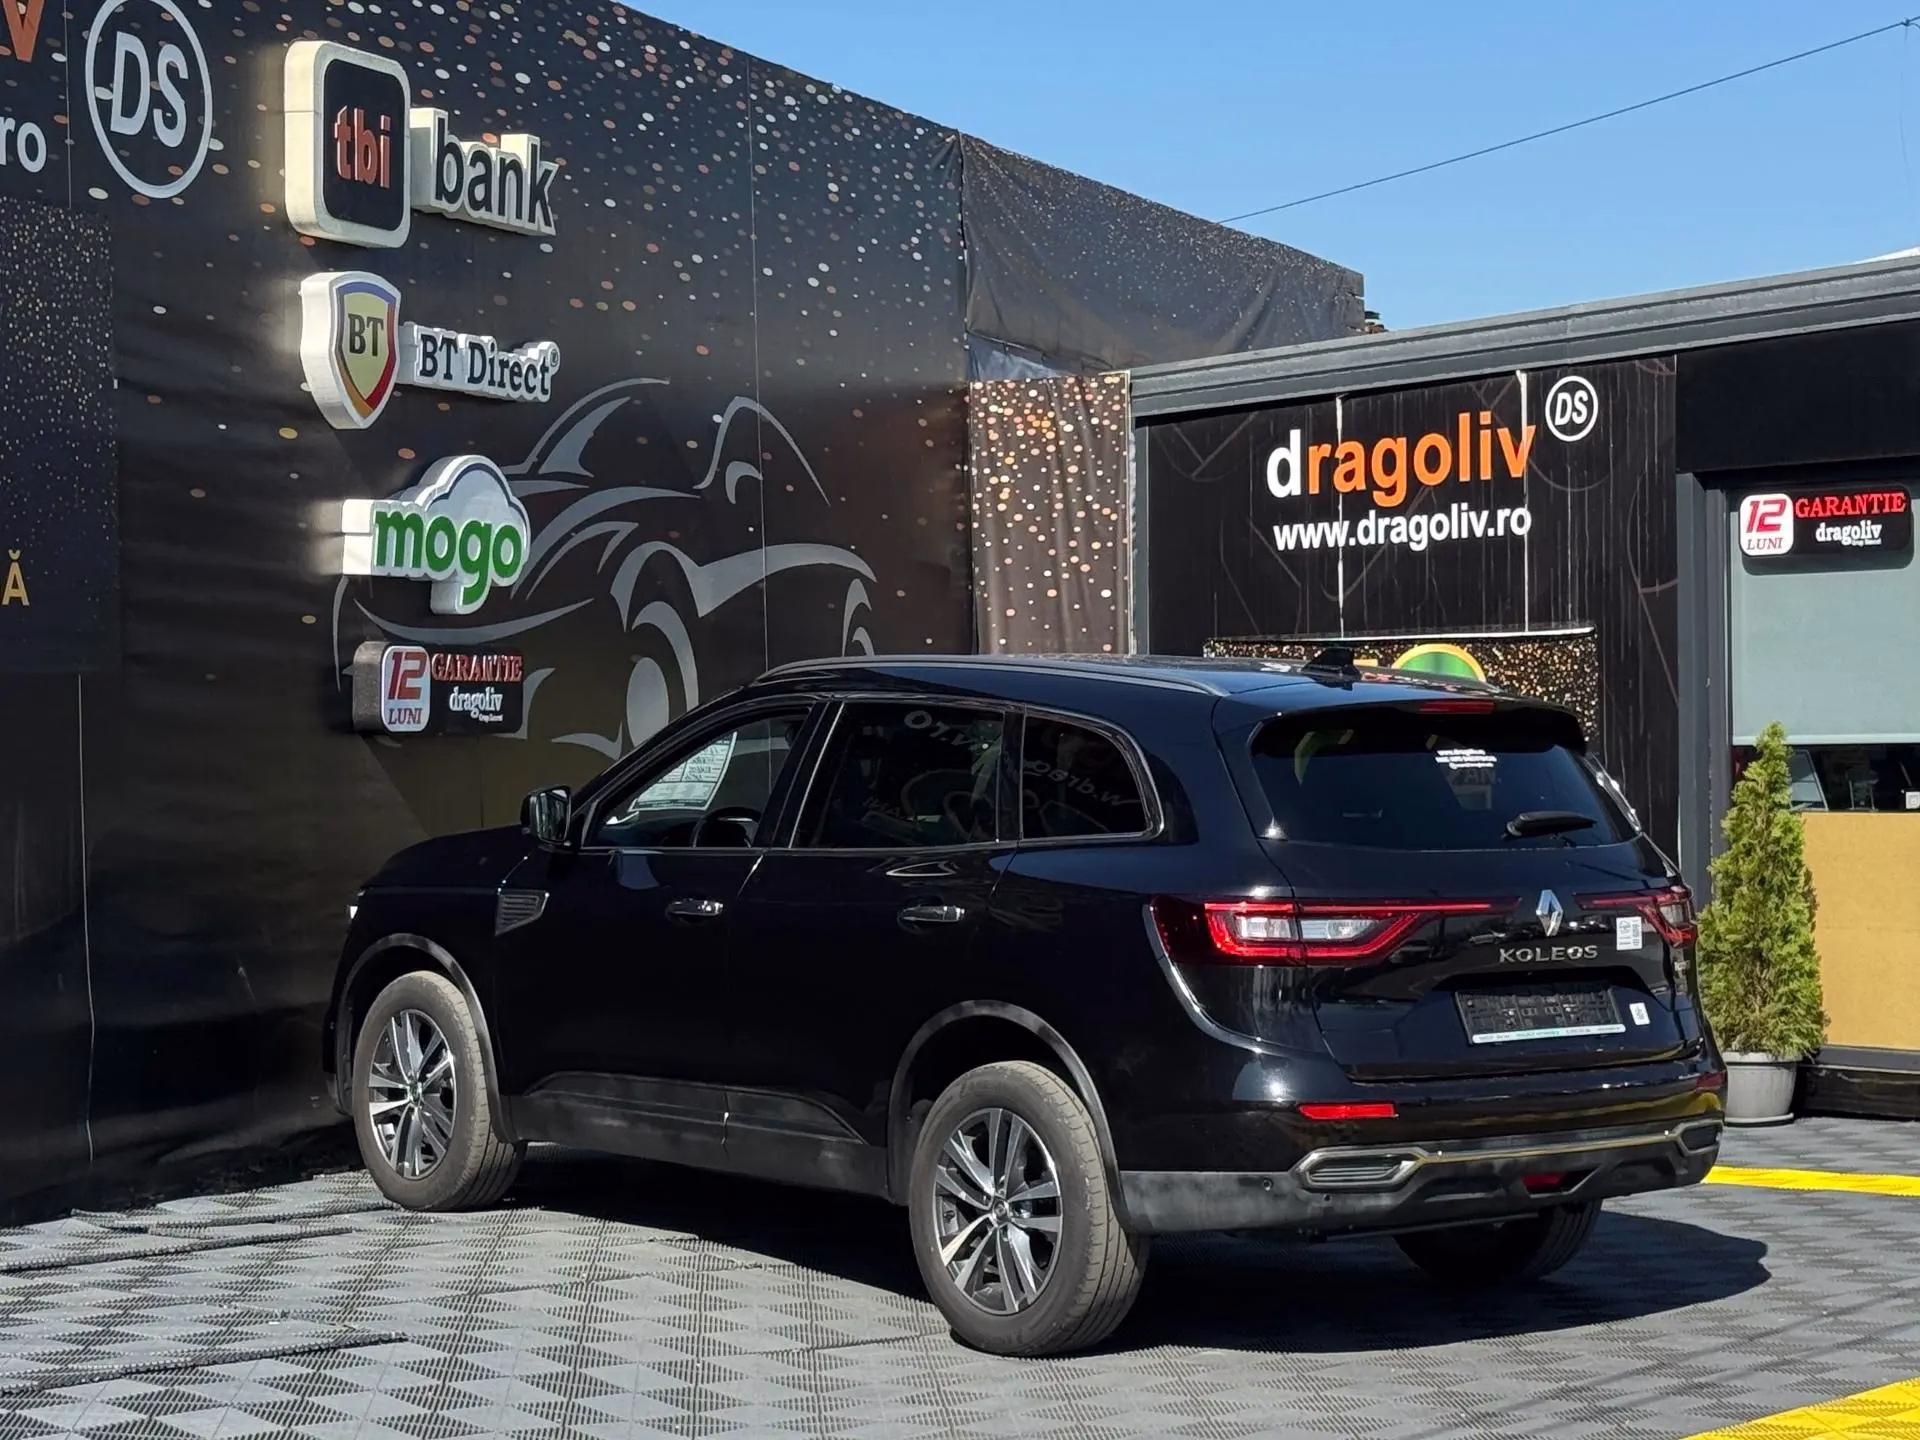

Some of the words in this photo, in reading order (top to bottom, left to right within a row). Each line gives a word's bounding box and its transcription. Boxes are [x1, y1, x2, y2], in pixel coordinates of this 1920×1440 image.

[110, 31, 188, 148] DS
[334, 104, 391, 189] tbi
[435, 117, 552, 228] bank
[347, 312, 384, 358] BT
[419, 333, 458, 381] BT
[1554, 389, 1588, 426] DS
[1266, 410, 1537, 508] dragoliv
[1745, 498, 1787, 534] 12
[1795, 492, 1907, 518] GARANTIE
[1273, 502, 1533, 552] www.dragoliv.ro
[1747, 537, 1783, 551] LUNI
[1815, 519, 1883, 547] dragoliv
[375, 511, 522, 605] mogo
[388, 651, 428, 700] 12
[431, 652, 524, 682] GARANTIE
[388, 707, 423, 725] LUNI
[449, 685, 504, 719] dragoliv
[1499, 945, 1599, 963] KOLEOS
